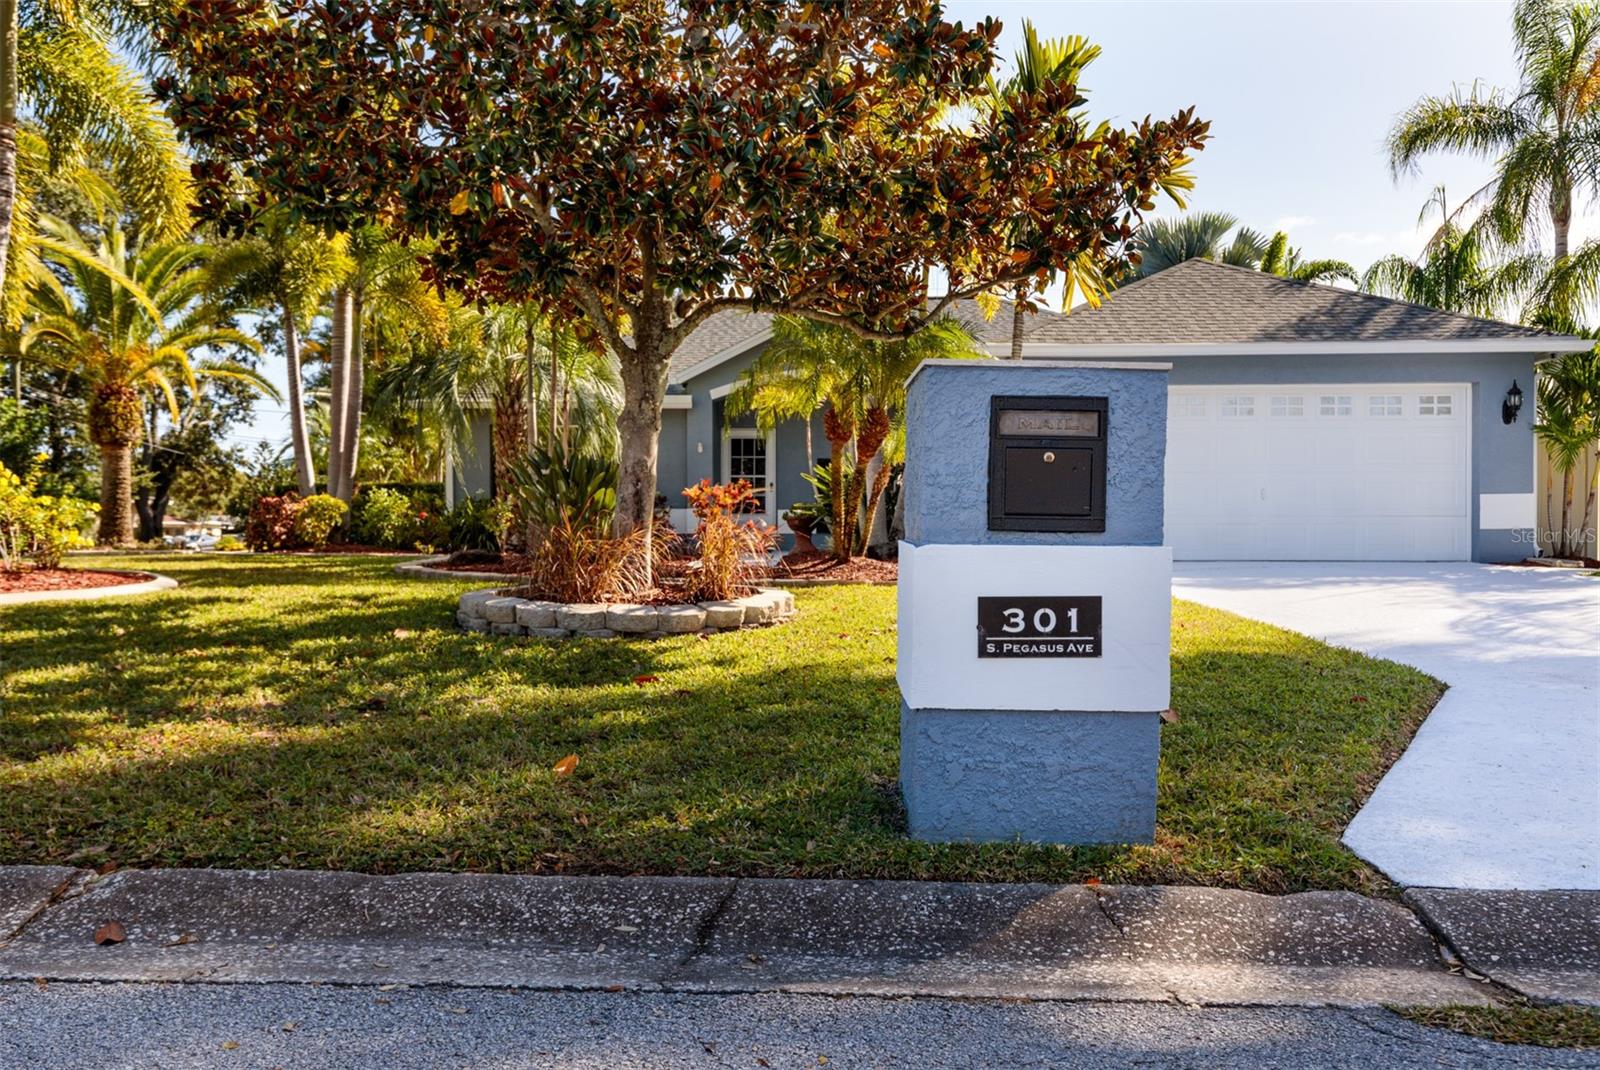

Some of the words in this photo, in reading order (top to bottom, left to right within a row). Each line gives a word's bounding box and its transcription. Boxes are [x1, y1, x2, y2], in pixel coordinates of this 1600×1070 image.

[1017, 417, 1080, 431] MAIL
[1002, 608, 1079, 633] 301
[986, 643, 1000, 653] S.
[1003, 643, 1064, 653] PEGASUS
[1066, 643, 1094, 653] AVE
